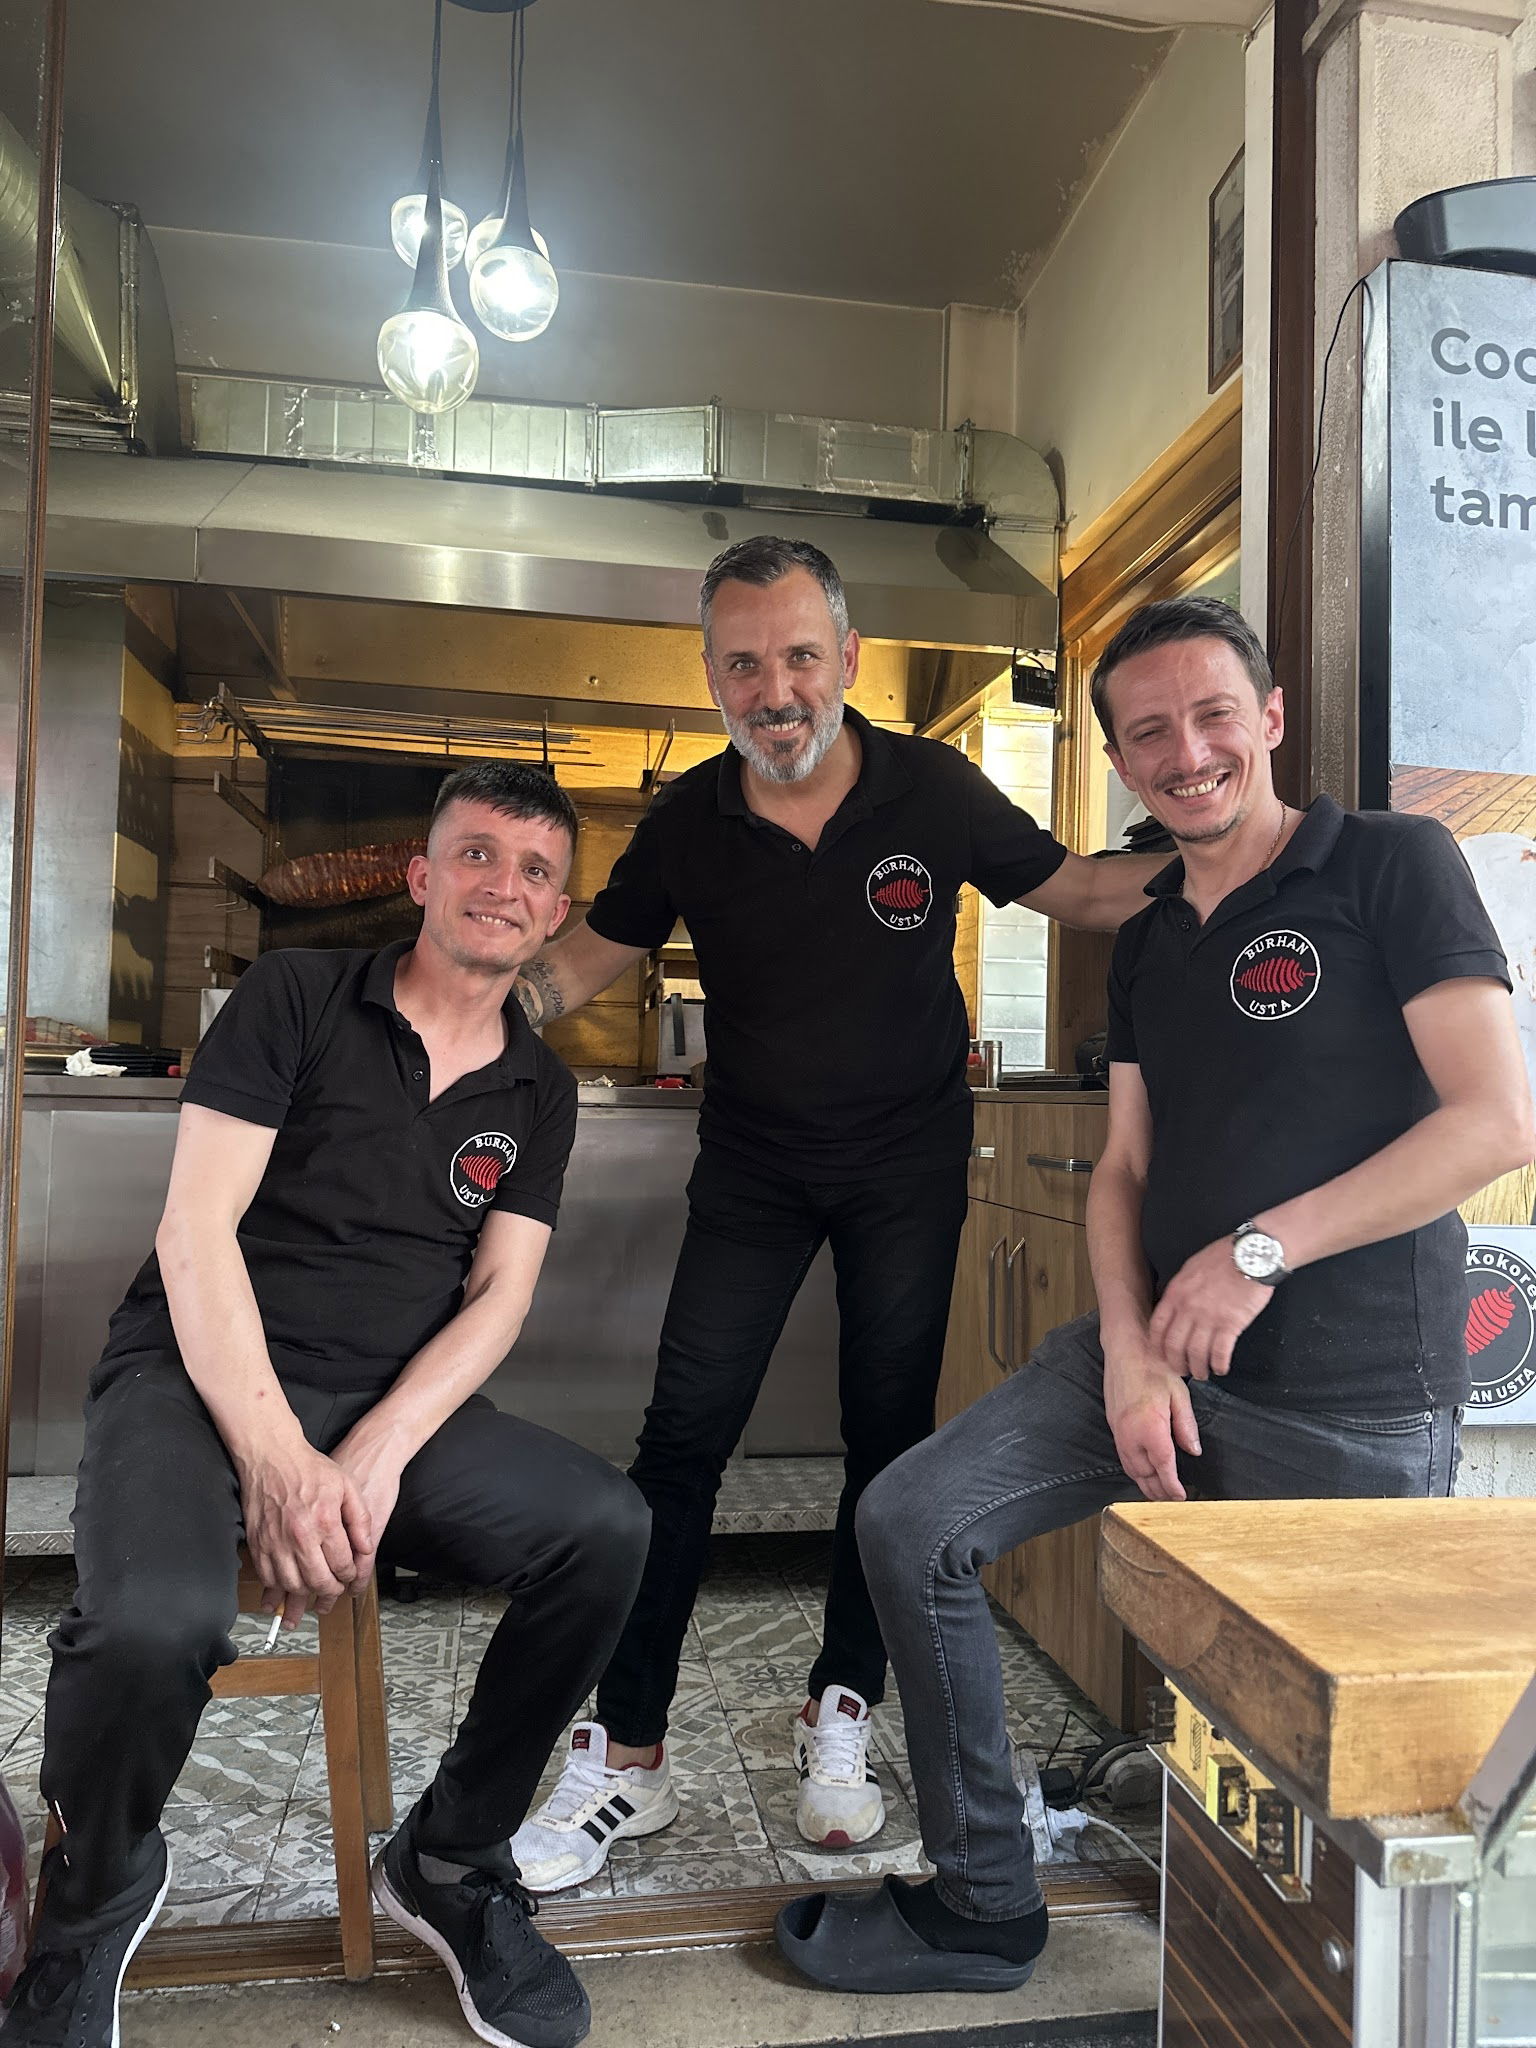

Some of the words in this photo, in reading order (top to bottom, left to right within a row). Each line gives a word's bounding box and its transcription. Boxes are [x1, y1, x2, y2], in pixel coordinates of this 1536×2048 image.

[1433, 397, 1502, 453] ile
[1430, 475, 1536, 531] tam
[873, 860, 923, 880] BURHAN
[889, 913, 921, 927] USTA
[1244, 935, 1309, 960] BURHAN
[1249, 999, 1292, 1015] USTA
[1495, 1367, 1536, 1399] USTA
